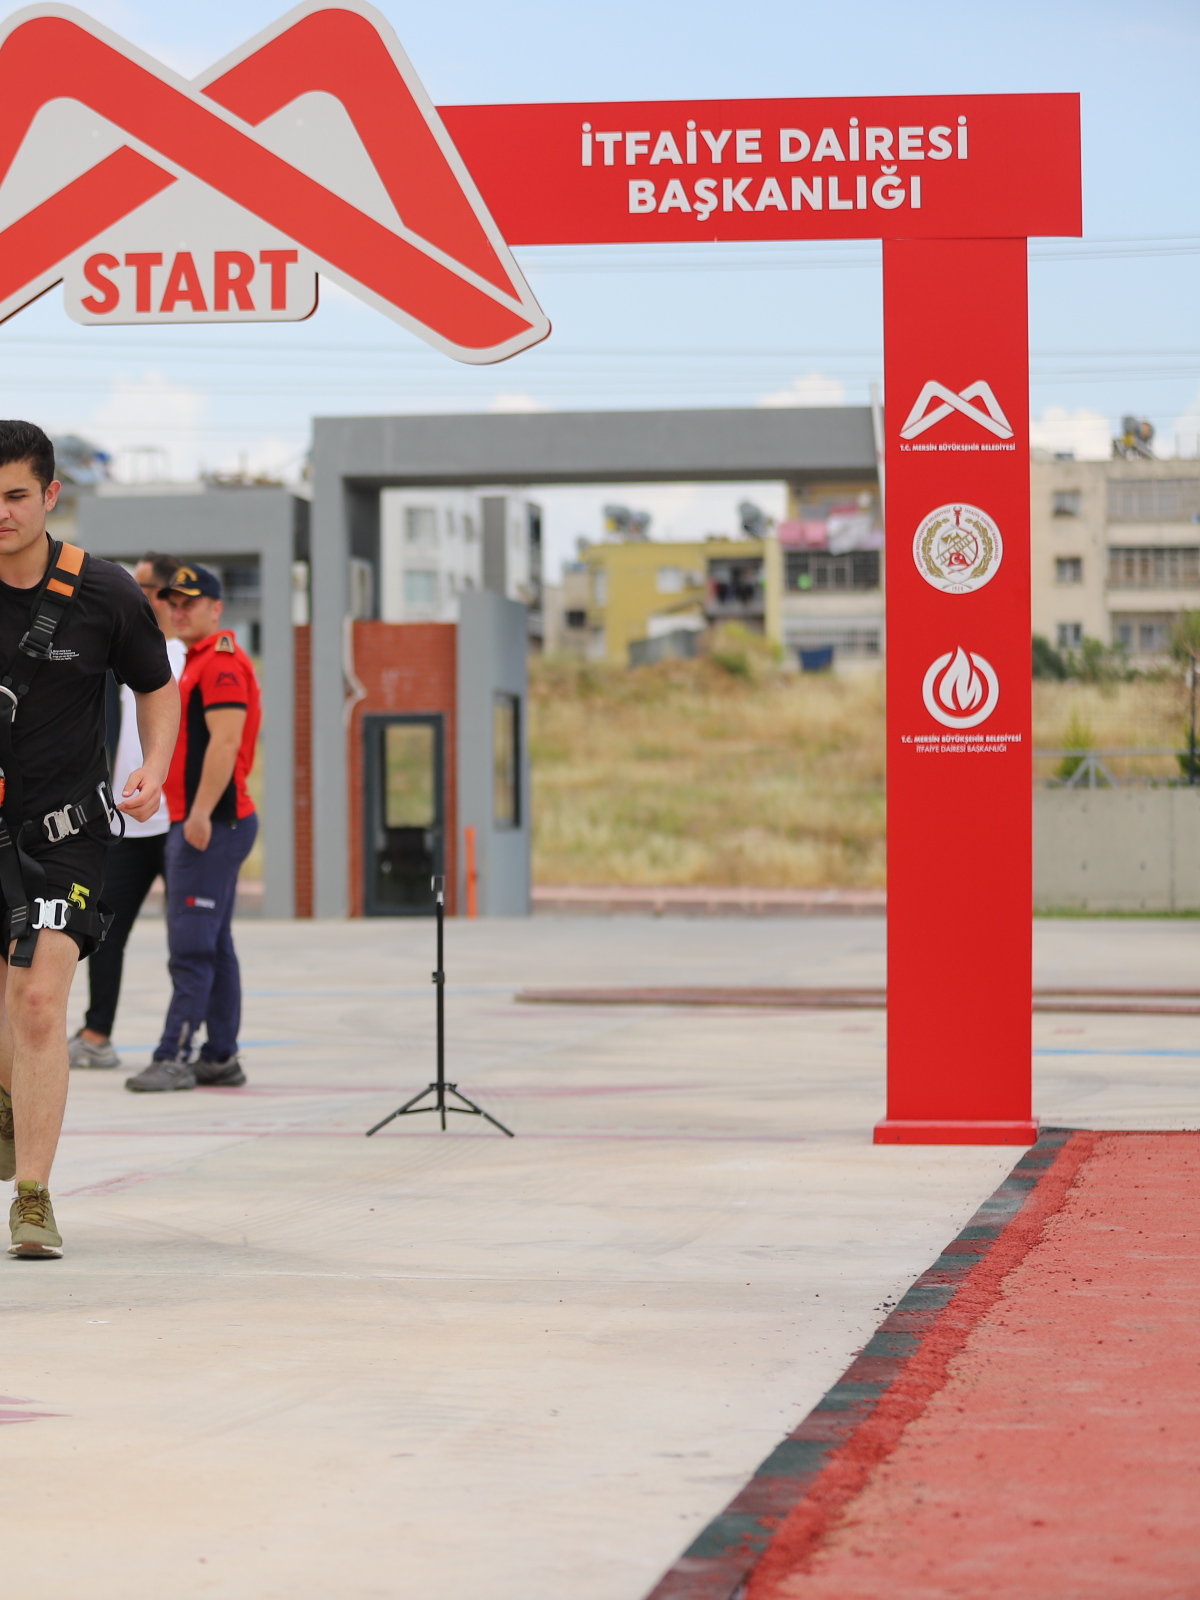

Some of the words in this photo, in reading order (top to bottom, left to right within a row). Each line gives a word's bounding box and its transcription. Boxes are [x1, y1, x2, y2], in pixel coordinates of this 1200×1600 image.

[581, 120, 763, 167] İTFAİYE
[779, 115, 968, 163] DAİRESİ
[628, 165, 922, 221] BAŞKANLIĞI
[81, 249, 299, 315] START
[912, 442, 938, 452] MERSİN
[914, 733, 940, 744] MERSİN
